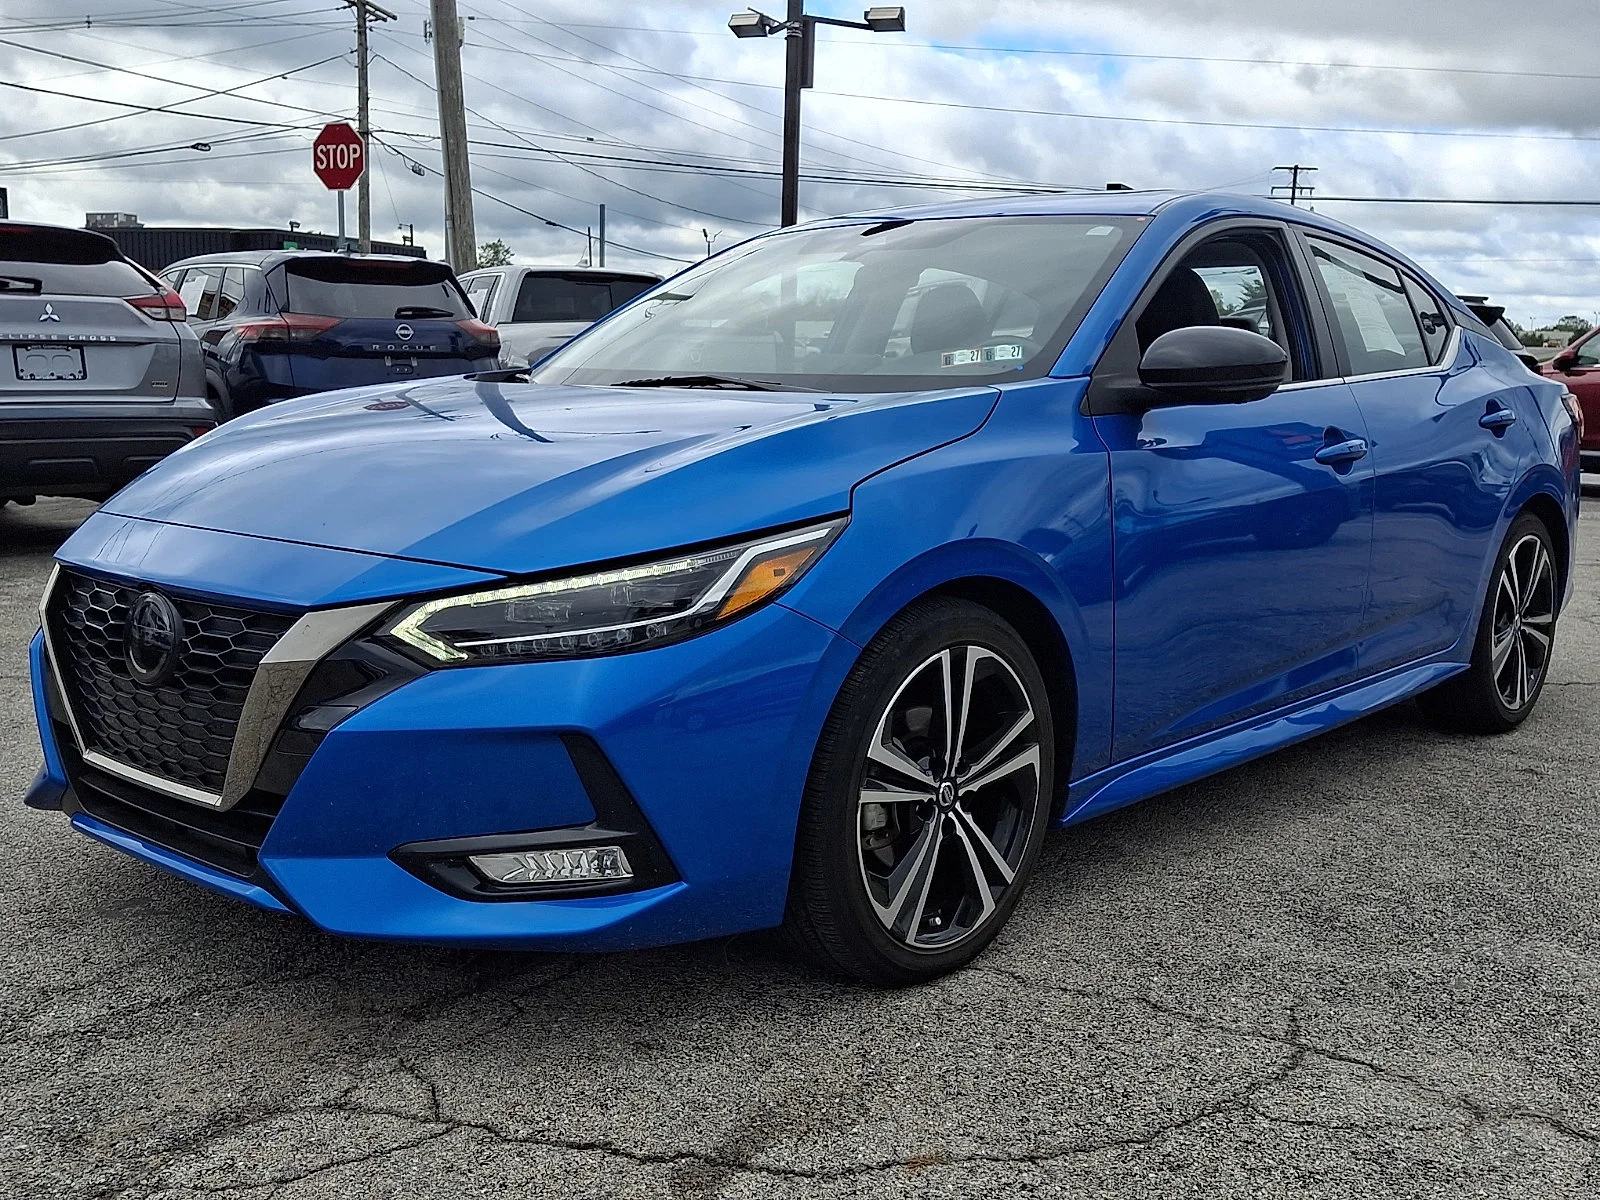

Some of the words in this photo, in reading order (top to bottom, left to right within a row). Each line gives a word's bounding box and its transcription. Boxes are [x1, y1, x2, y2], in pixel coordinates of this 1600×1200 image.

[316, 144, 361, 170] STOP
[970, 350, 980, 361] 27
[1011, 346, 1021, 358] 27
